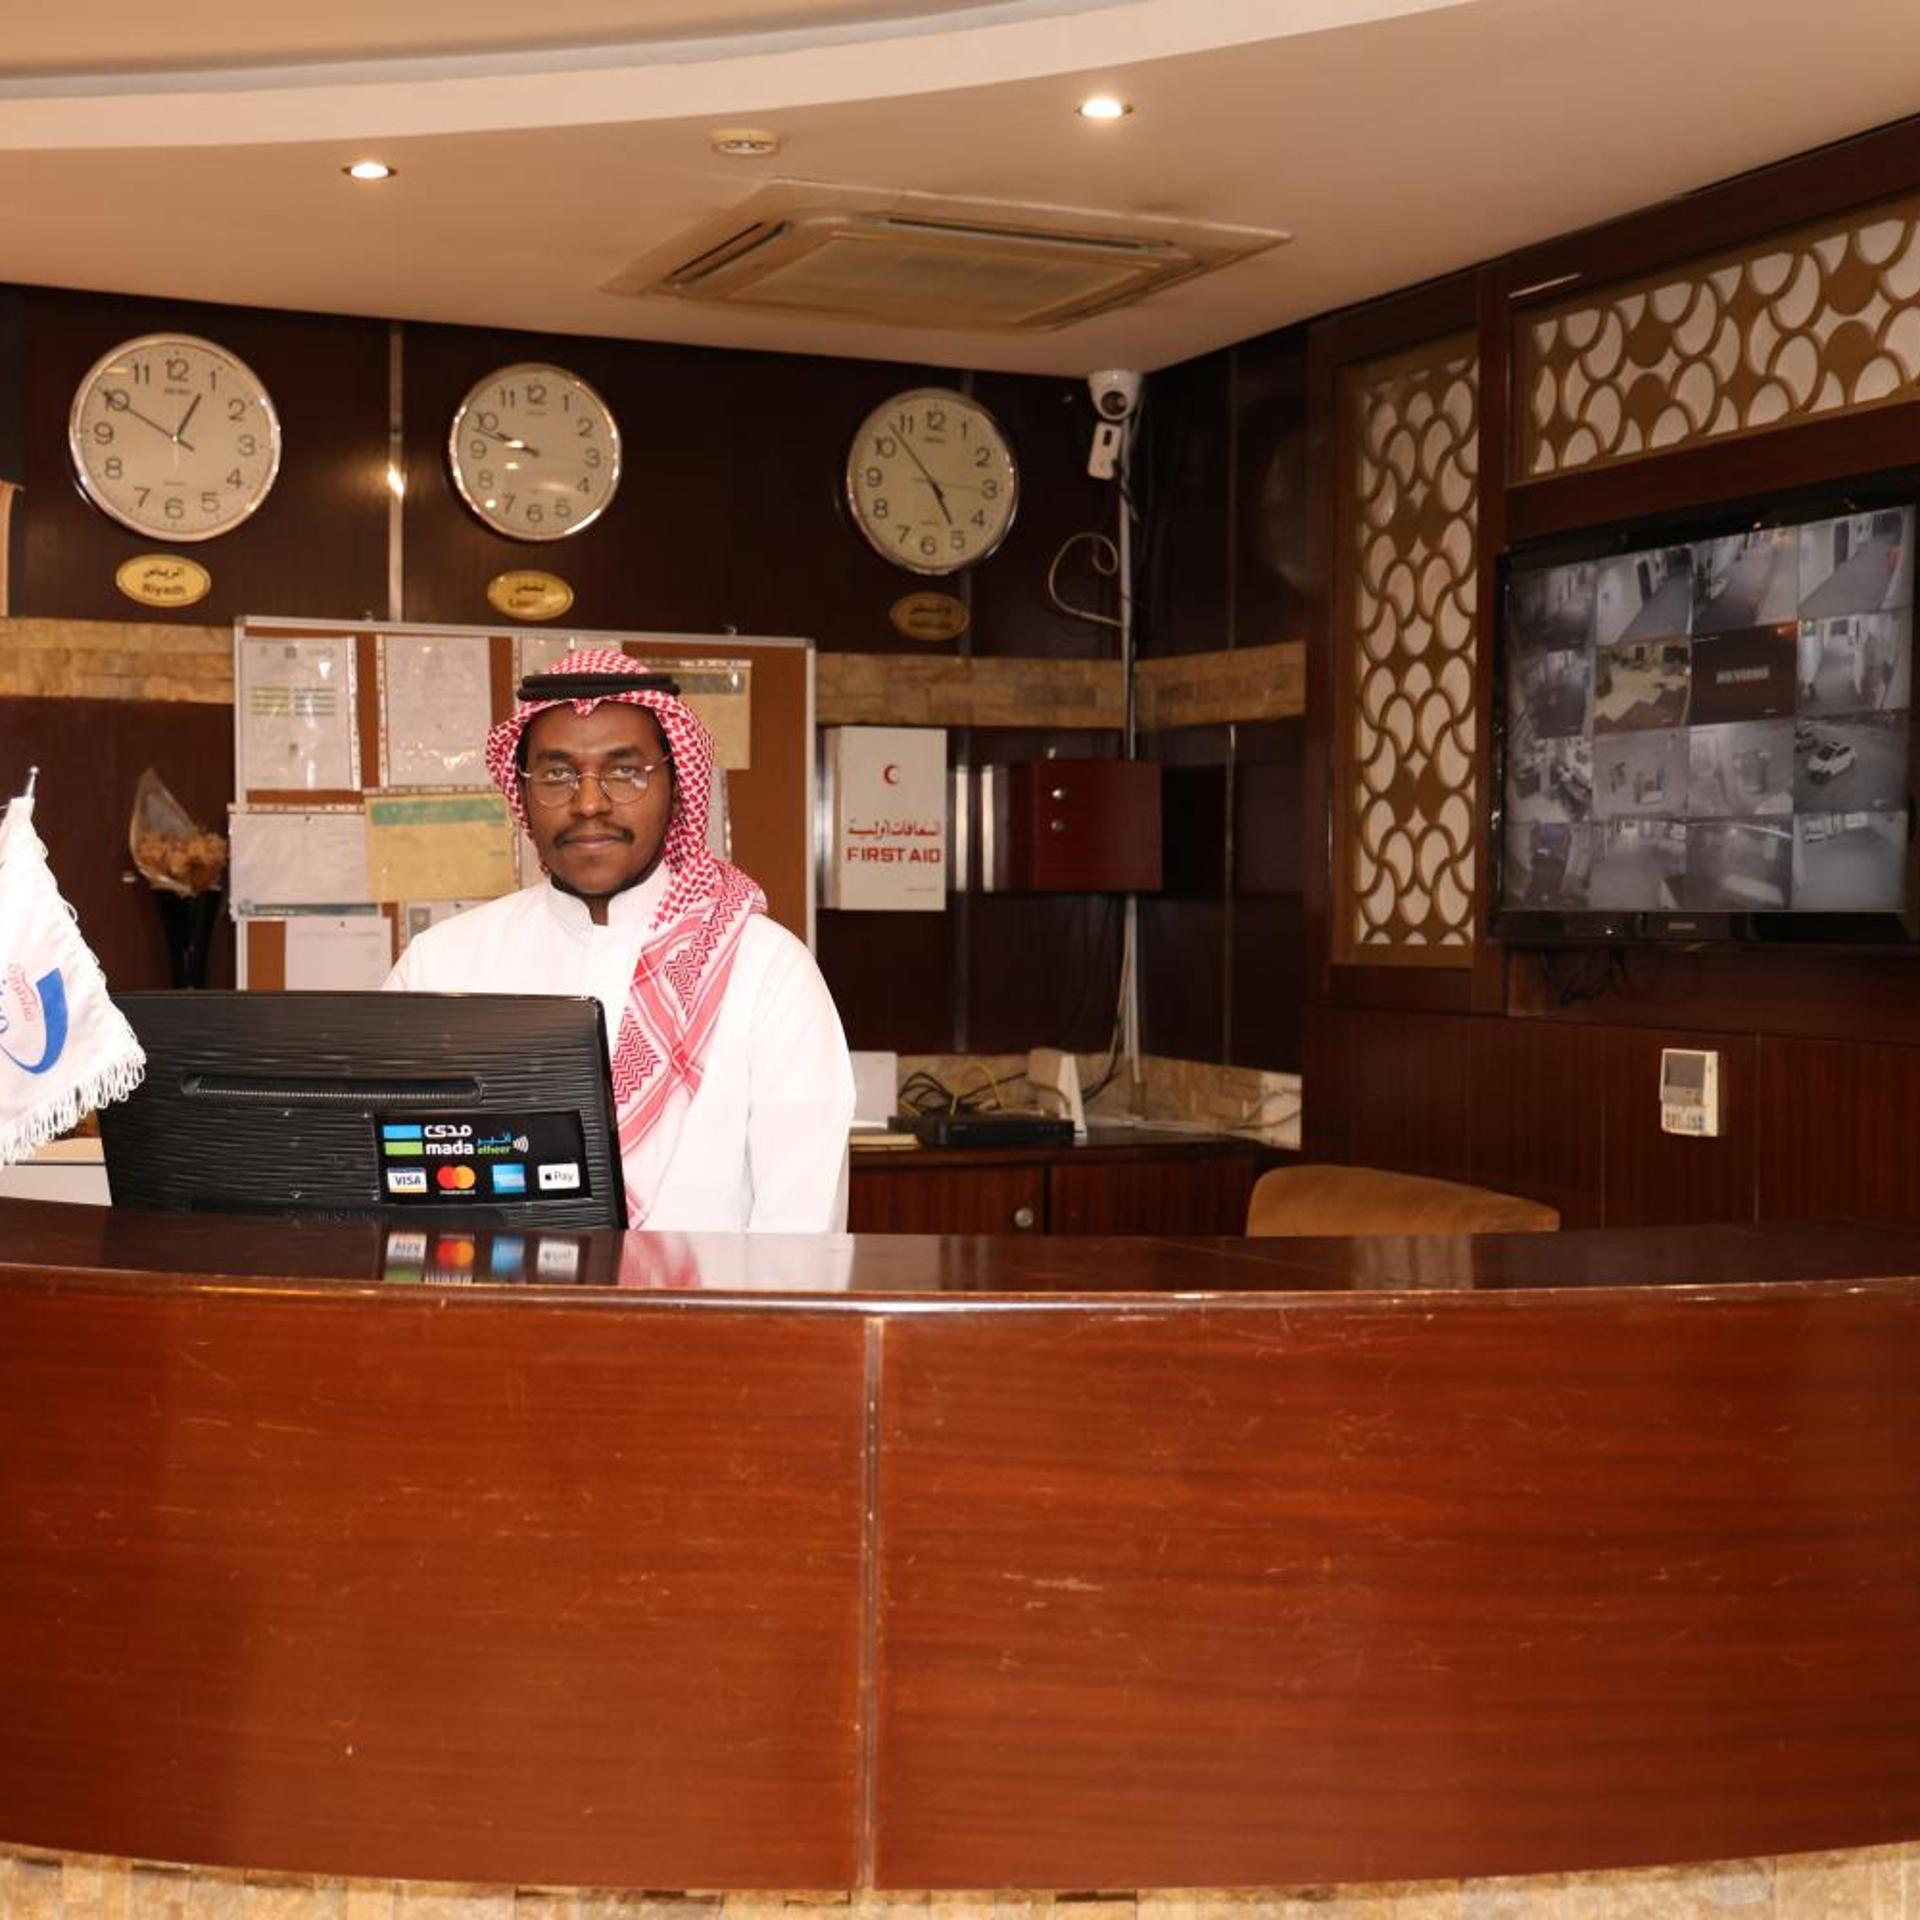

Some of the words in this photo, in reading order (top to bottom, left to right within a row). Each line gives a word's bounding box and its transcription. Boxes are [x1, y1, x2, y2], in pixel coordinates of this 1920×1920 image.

[133, 363, 150, 385] 11
[165, 358, 190, 381] 12
[208, 370, 217, 391] 1
[103, 388, 130, 412] 10
[500, 389, 515, 409] 11
[527, 384, 547, 405] 12
[563, 394, 569, 412] 1
[228, 399, 246, 421] 2
[476, 412, 499, 432] 10
[578, 418, 593, 438] 2
[900, 414, 914, 434] 11
[926, 410, 946, 431] 12
[93, 422, 114, 445] 9
[961, 421, 967, 441] 1
[237, 434, 256, 457] 3
[470, 440, 487, 460] 9
[875, 437, 897, 459] 10
[585, 448, 601, 468] 3
[975, 447, 991, 468] 2
[104, 457, 123, 480] 8
[866, 467, 883, 488] 9
[226, 468, 243, 490] 4
[478, 470, 494, 490] 8
[577, 477, 590, 494] 4
[133, 486, 151, 508] 7
[982, 479, 998, 500] 3
[165, 498, 184, 520] 6
[201, 491, 220, 513] 5
[501, 493, 516, 513] 7
[555, 498, 571, 518] 5
[873, 498, 888, 519] 8
[526, 504, 543, 523] 6
[971, 509, 985, 528] 4
[896, 525, 912, 544] 7
[951, 530, 966, 550] 5
[920, 537, 937, 556] 6
[847, 847, 906, 863] FIRST
[909, 847, 941, 863] AID
[426, 1139, 475, 1155] mada
[395, 1176, 422, 1186] VISA
[554, 1172, 574, 1183] Pay
